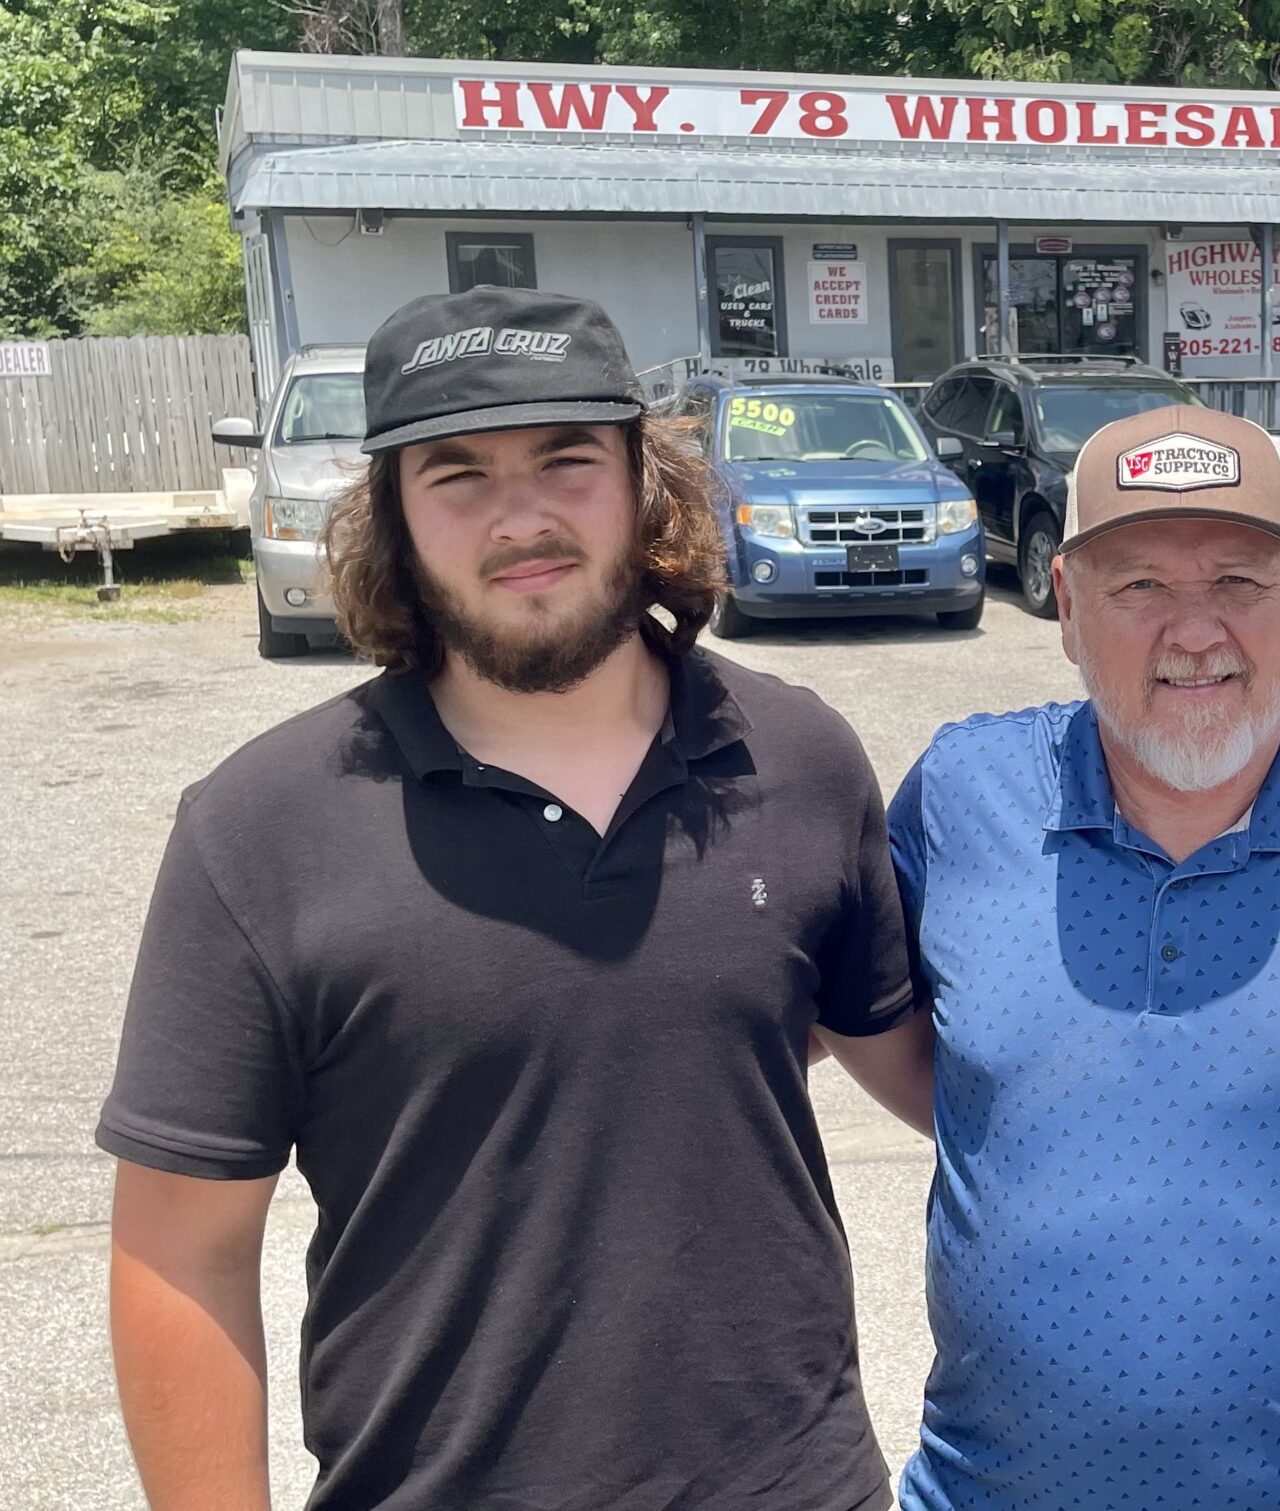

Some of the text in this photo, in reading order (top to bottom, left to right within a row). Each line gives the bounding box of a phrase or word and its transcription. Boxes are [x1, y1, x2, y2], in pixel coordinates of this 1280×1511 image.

[458, 80, 696, 133] HWY.
[740, 89, 849, 138] 78
[1168, 243, 1280, 275] HIGHWA
[828, 266, 847, 277] WE
[733, 281, 771, 299] Clean
[813, 280, 861, 291] ACCEPT
[720, 302, 773, 311] USED CARS
[815, 294, 861, 305] CREDIT
[818, 308, 859, 319] CARDS
[729, 319, 766, 328] TRUCKS
[401, 327, 571, 375] SANTA CRUZ
[731, 397, 796, 427] 5500
[1128, 447, 1229, 472] TSC TRACTOR
[1154, 461, 1211, 475] SUPPLY
